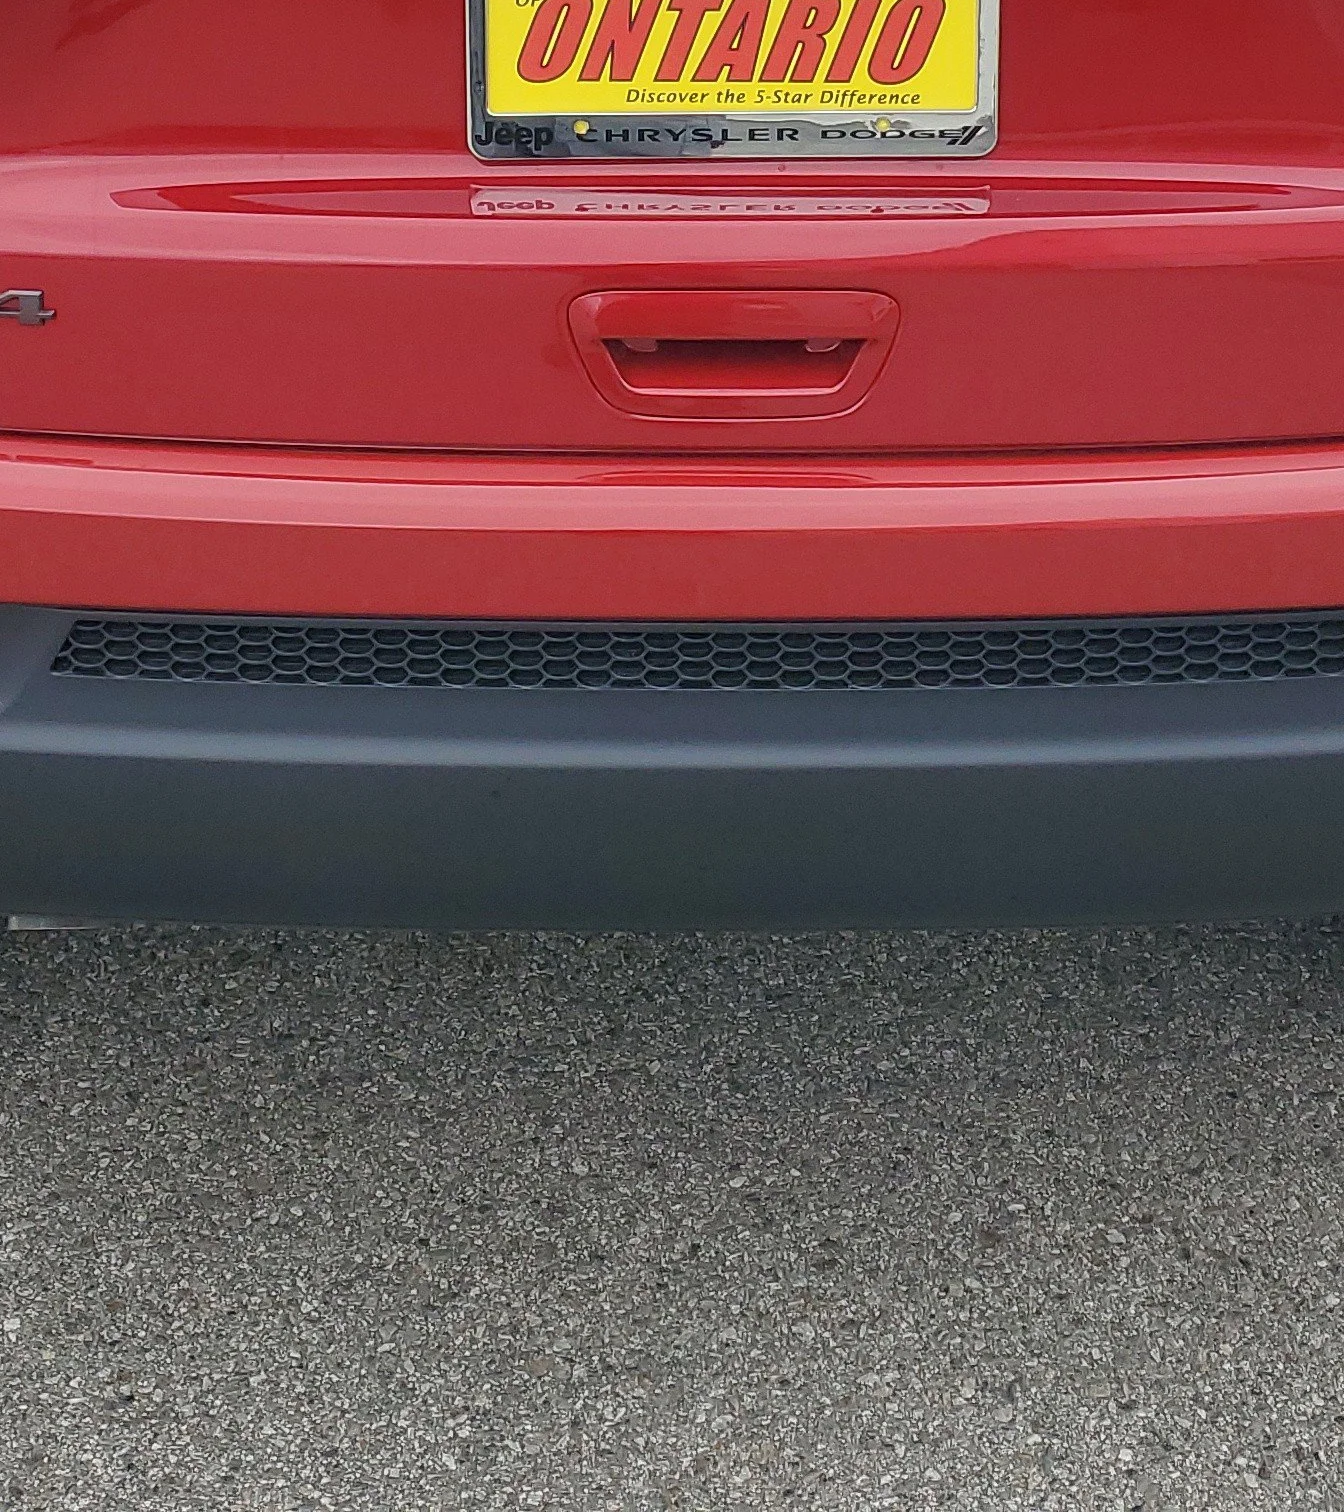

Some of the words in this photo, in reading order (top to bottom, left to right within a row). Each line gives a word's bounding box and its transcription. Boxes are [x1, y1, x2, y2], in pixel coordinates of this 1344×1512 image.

[625, 88, 710, 105] Discover
[716, 88, 747, 105] the
[753, 89, 813, 105] 5-Star
[819, 89, 921, 108] Difference
[474, 121, 555, 152] Jeep
[575, 126, 800, 143] CHRYSLER
[820, 126, 964, 141] DODGE
